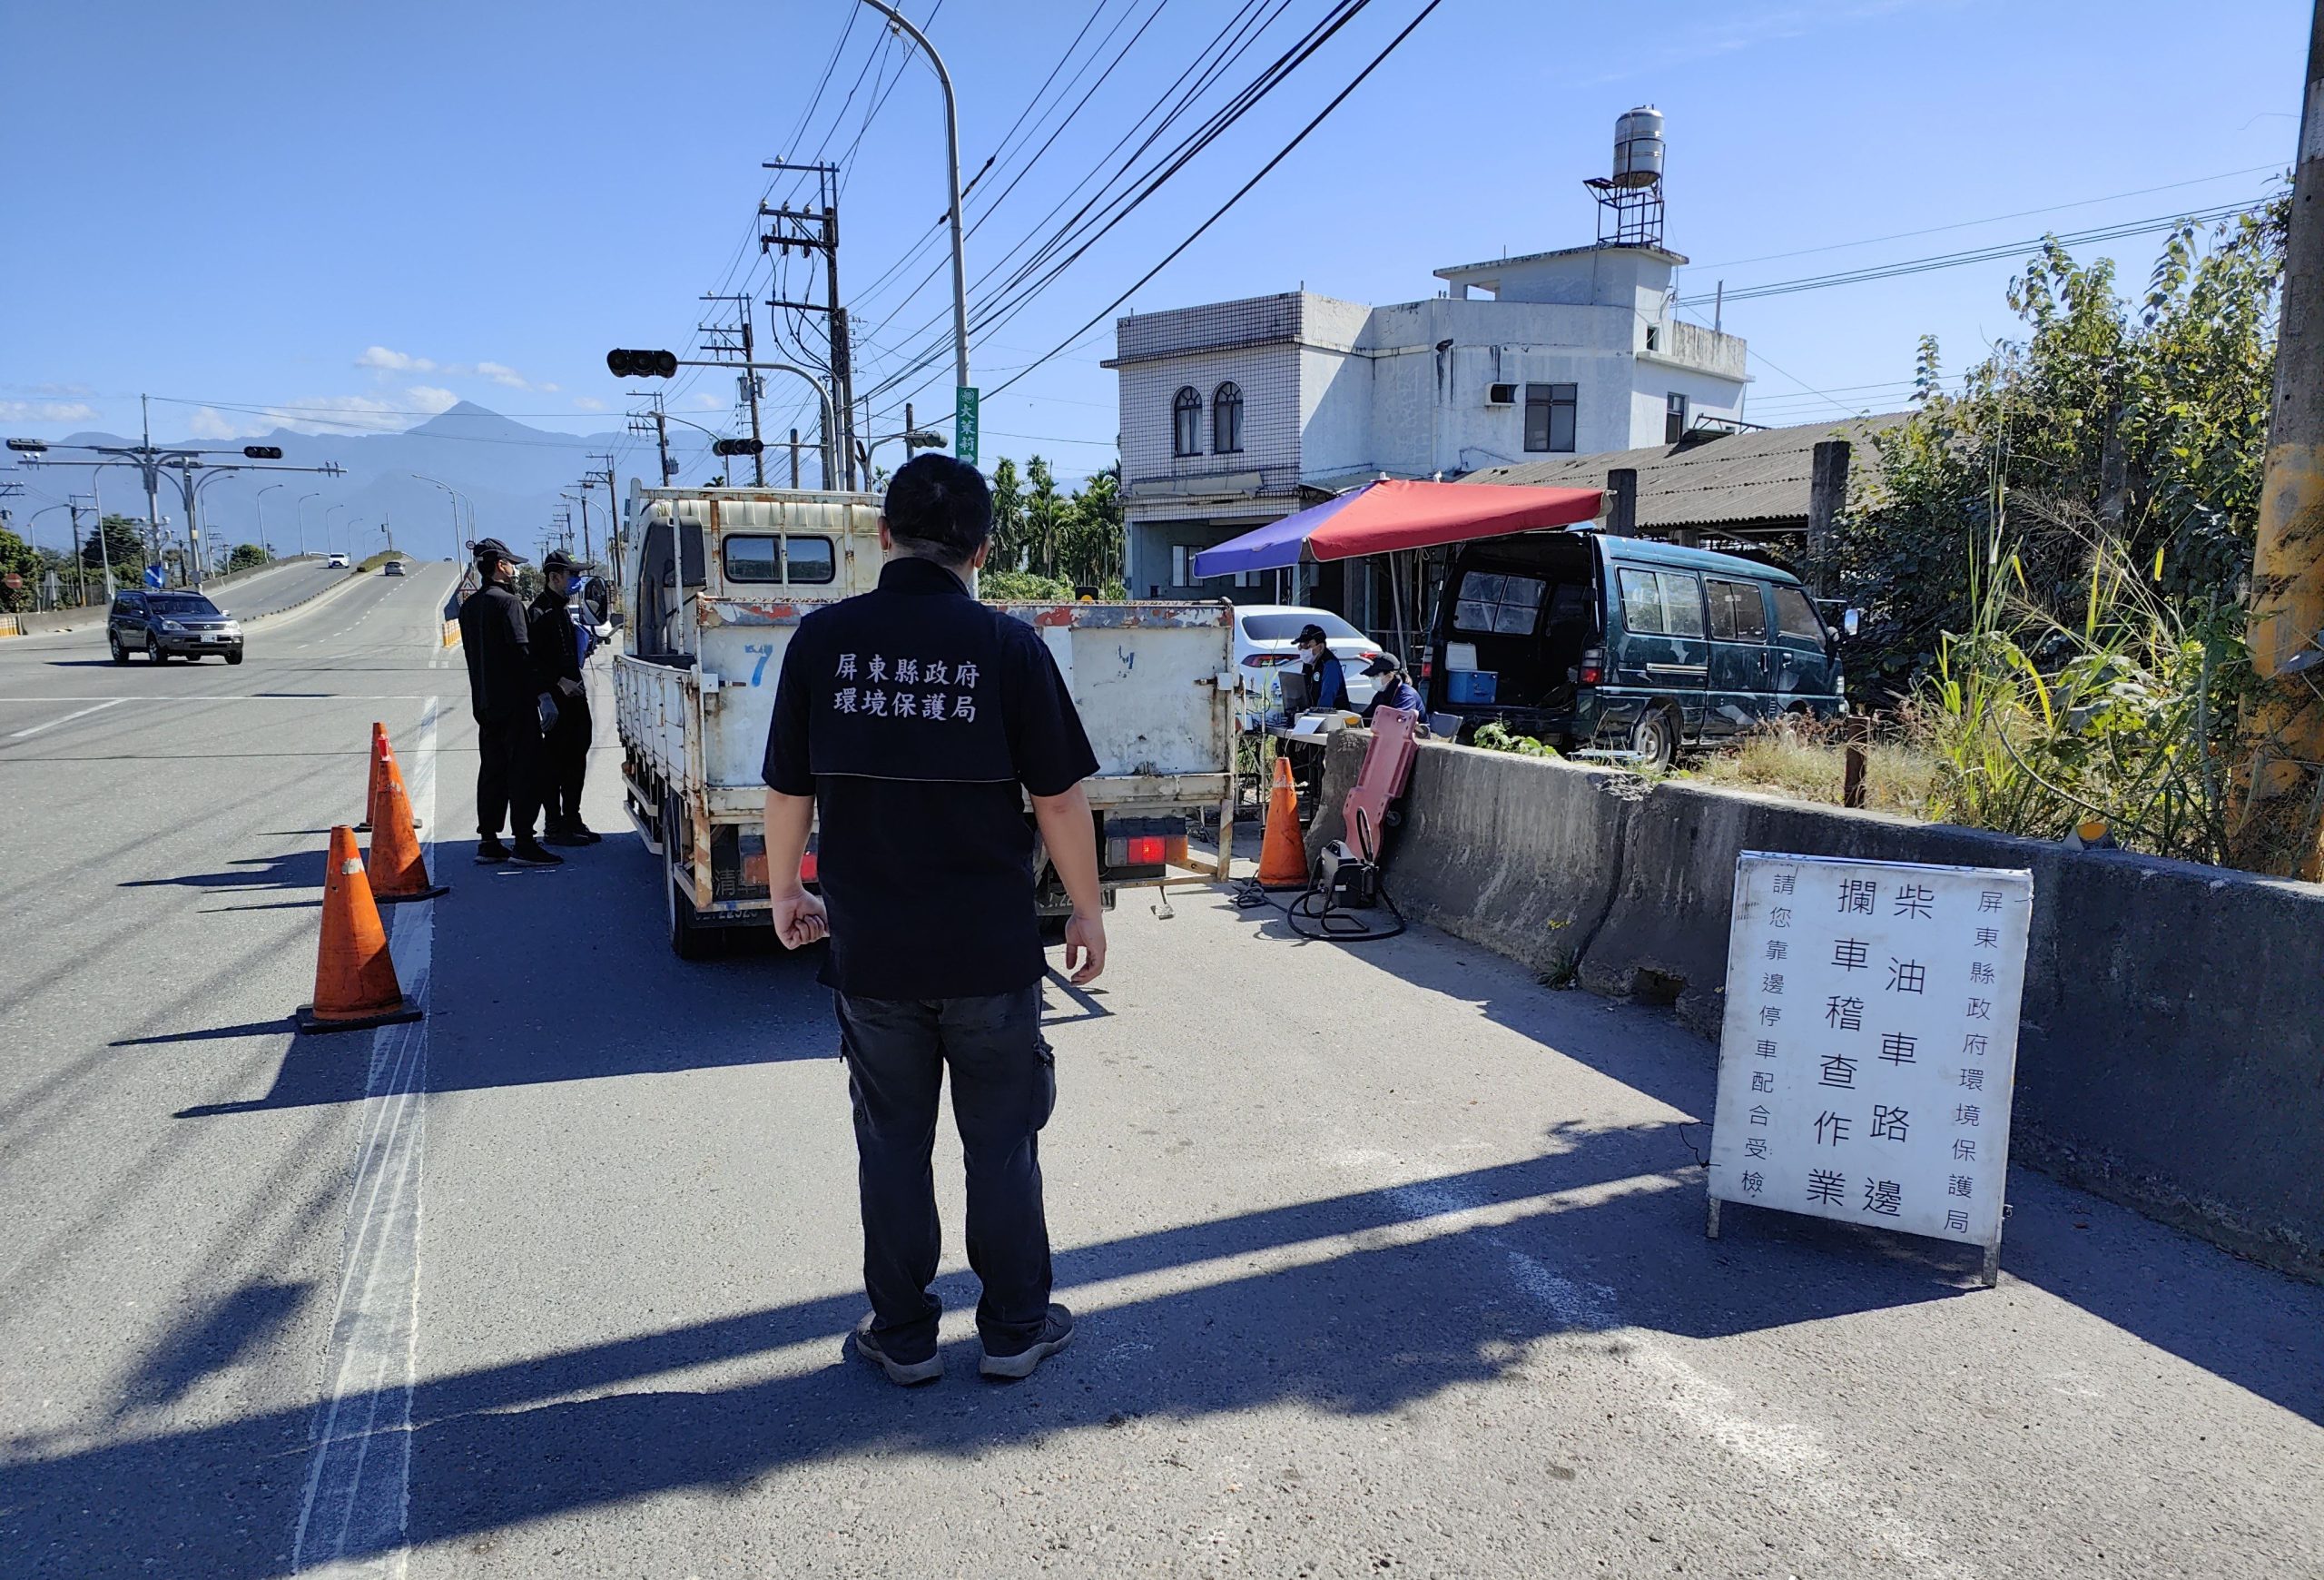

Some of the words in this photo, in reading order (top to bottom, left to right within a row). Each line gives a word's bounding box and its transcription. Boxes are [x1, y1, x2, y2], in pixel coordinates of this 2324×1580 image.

[959, 404, 976, 451] 大茉莉
[833, 686, 976, 724] 環境保護局
[834, 653, 980, 689] 屏東縣政府
[1741, 874, 1795, 1194] 請您靠邊停車配合受檢
[1807, 879, 1876, 1208] 攔車稽查作業
[1862, 884, 1935, 1218] 柴油車路邊
[1944, 891, 2003, 1234] 屏東縣政府環境保護局
